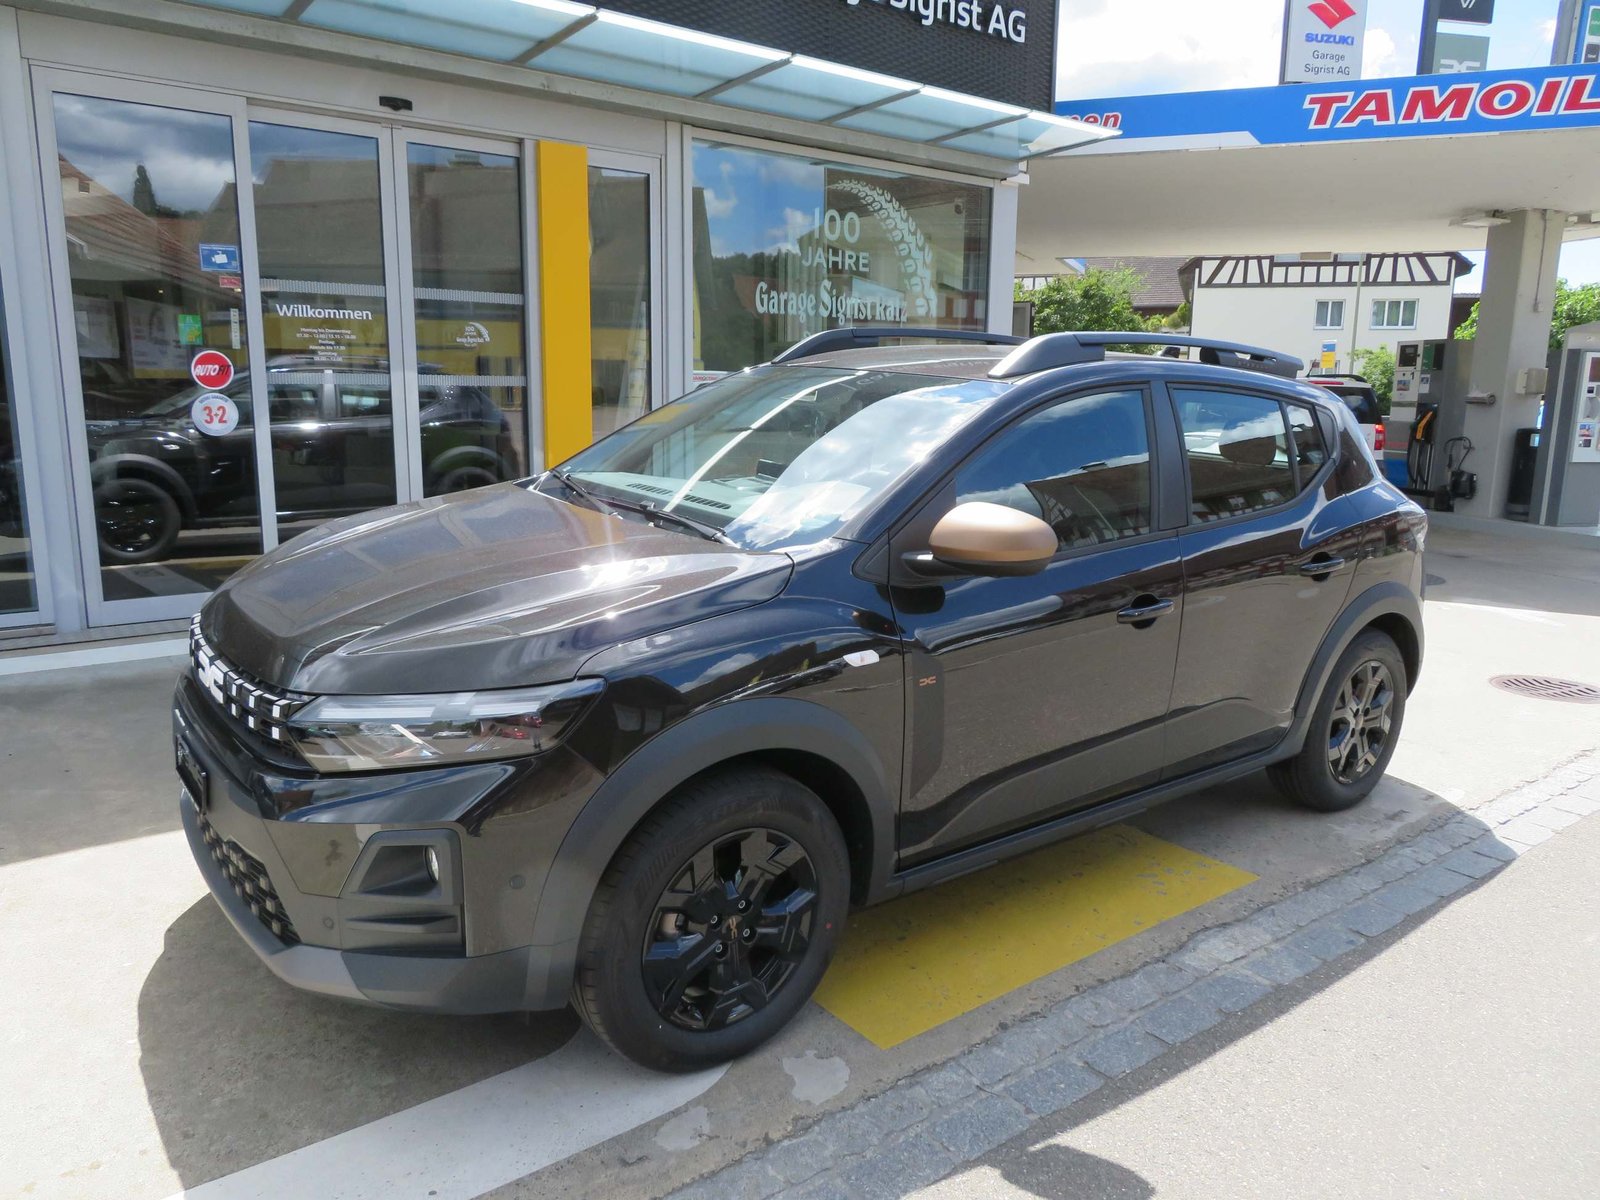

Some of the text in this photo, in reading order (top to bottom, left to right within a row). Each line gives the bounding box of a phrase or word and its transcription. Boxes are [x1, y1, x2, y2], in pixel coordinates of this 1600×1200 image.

[987, 4, 1026, 43] AG
[1304, 32, 1355, 46] SUZUKI
[1312, 50, 1345, 62] Garage
[1304, 63, 1350, 75] Sigrist AG
[1303, 75, 1600, 129] TAMOIL
[813, 207, 860, 243] 100
[802, 247, 870, 272] JAHRE
[276, 303, 372, 320] Willkommen
[755, 281, 816, 323] Garage
[820, 279, 873, 325] Sigrist
[194, 364, 232, 376] AUTOFIT
[202, 405, 228, 425] 3+2
